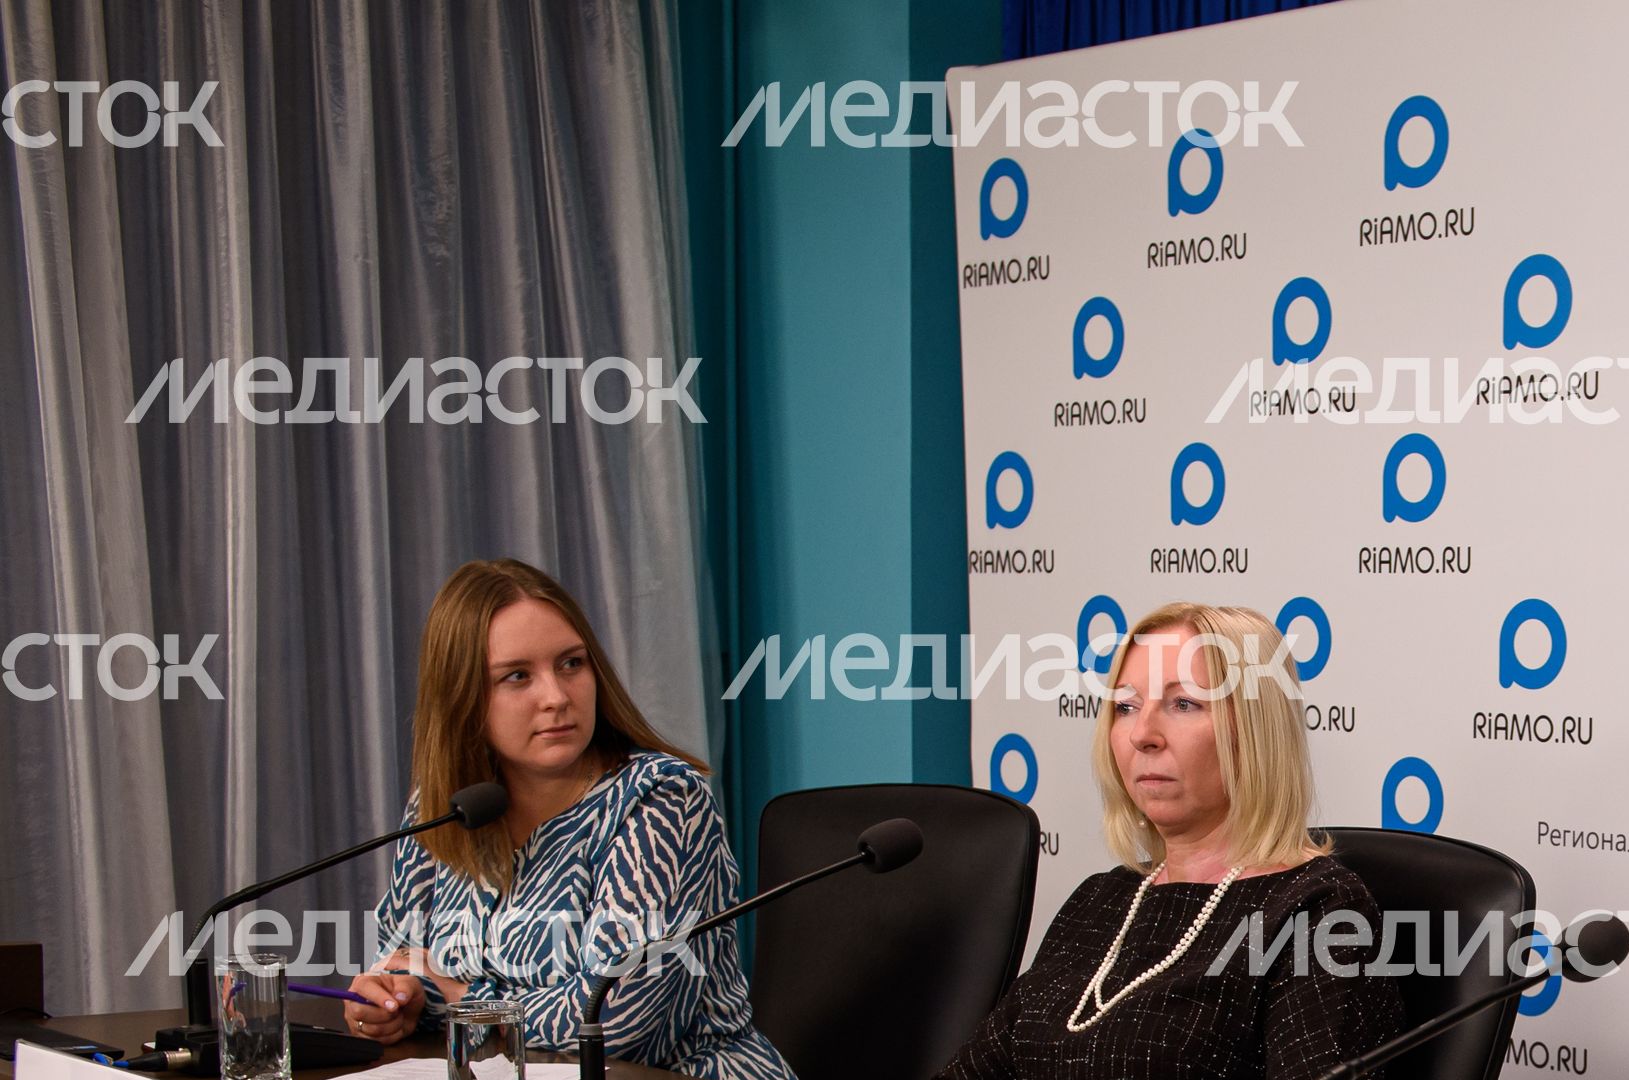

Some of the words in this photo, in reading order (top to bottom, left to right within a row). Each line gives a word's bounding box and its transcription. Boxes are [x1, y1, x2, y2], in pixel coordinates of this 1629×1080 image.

[1058, 692, 1102, 719] RiAM
[1305, 704, 1355, 733] O.RU
[1506, 1037, 1588, 1076] MO.RU
